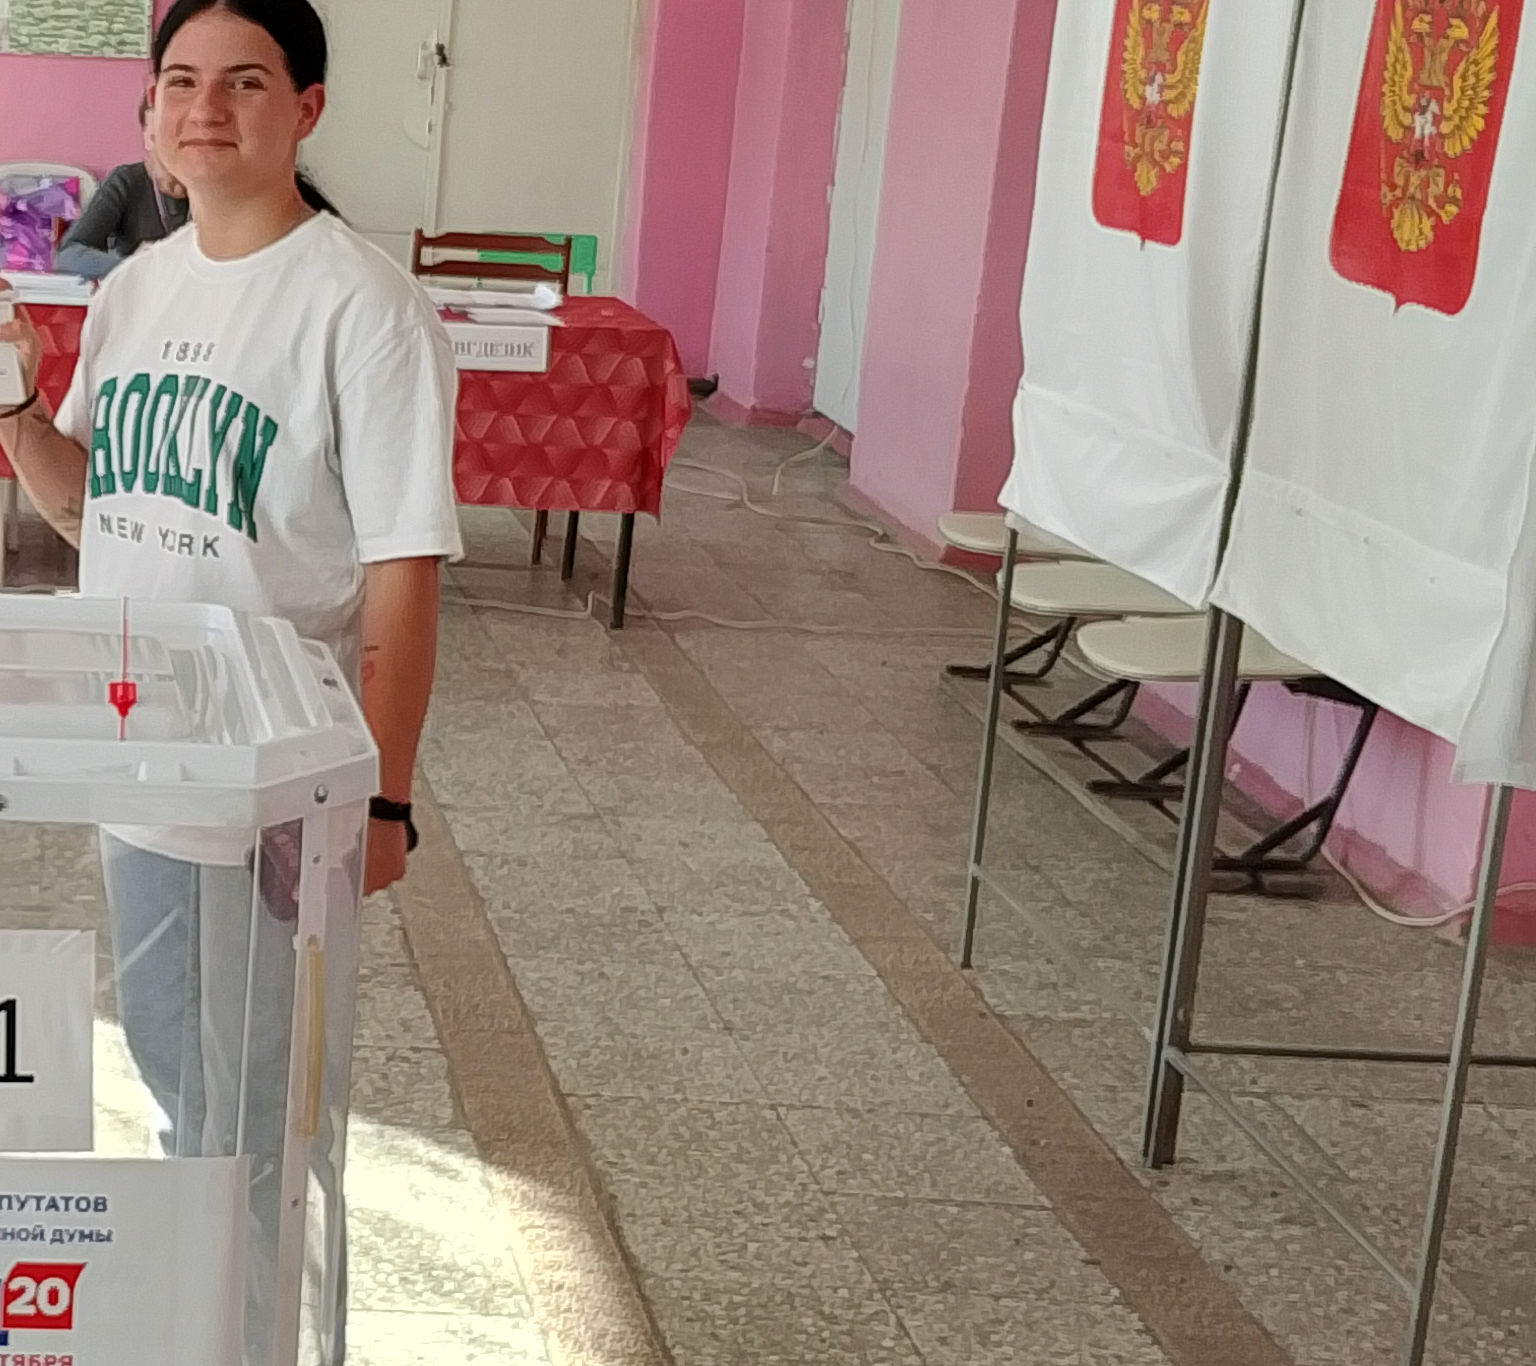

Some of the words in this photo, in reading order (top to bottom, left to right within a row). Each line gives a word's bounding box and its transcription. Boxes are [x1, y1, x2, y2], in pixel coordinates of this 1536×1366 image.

[90, 372, 279, 543] ROOKLYN
[98, 512, 145, 544] NEW
[49, 1227, 114, 1245] ДУМЫ
[6, 1276, 71, 1317] 20
